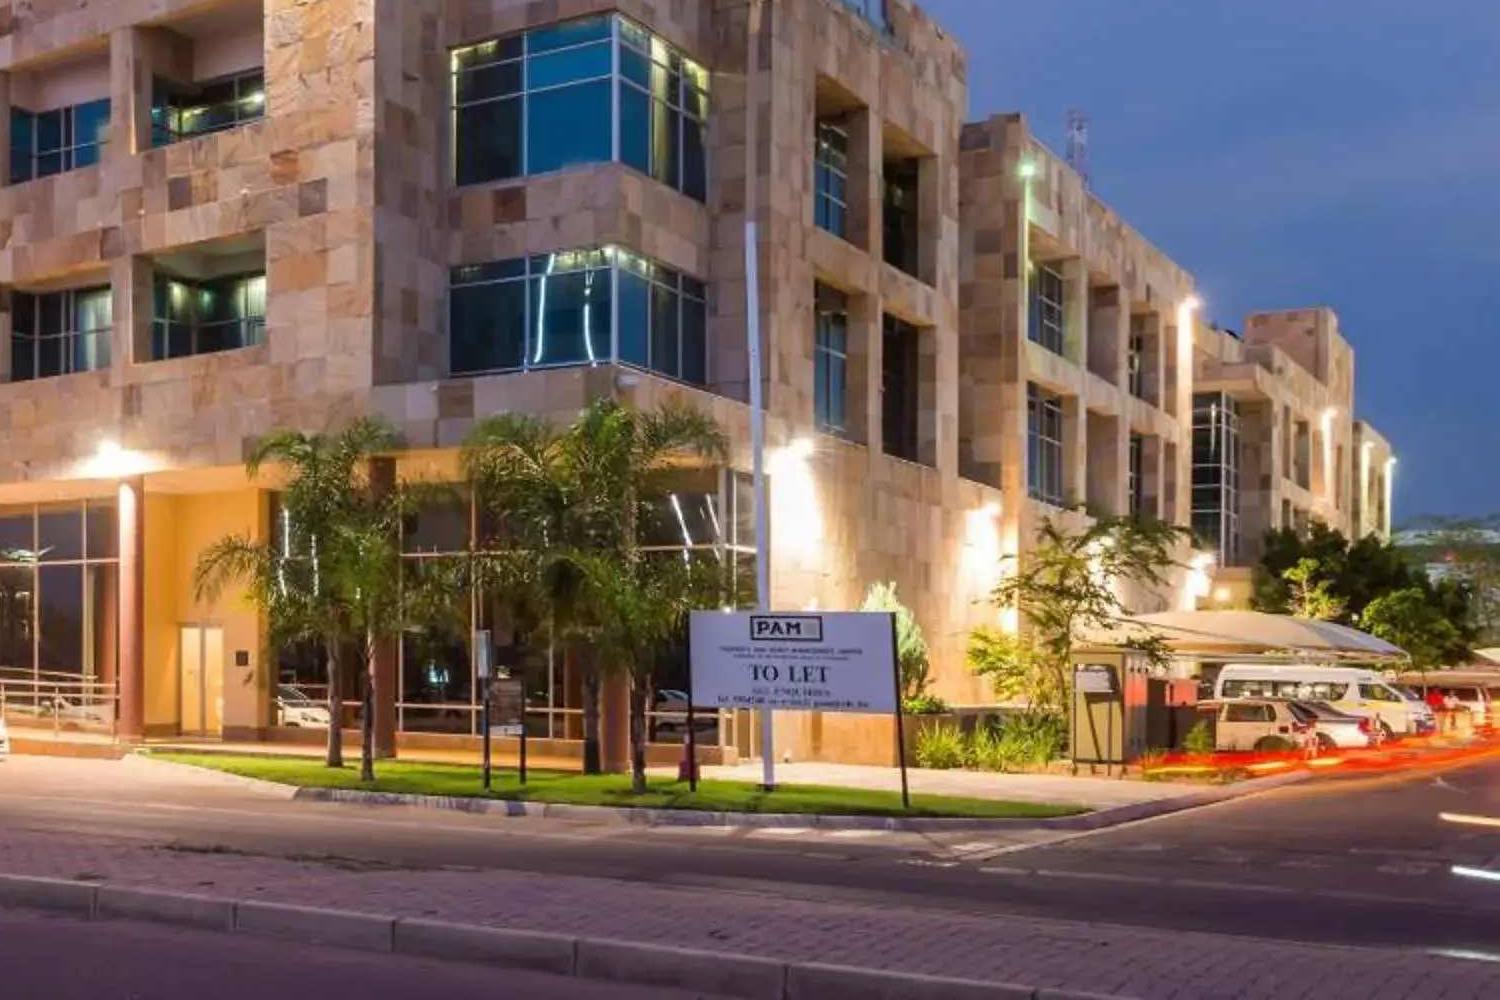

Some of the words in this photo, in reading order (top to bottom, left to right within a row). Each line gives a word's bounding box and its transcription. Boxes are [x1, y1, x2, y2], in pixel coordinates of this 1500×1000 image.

[757, 621, 801, 635] PAM
[749, 664, 779, 681] TO
[789, 665, 831, 683] LET
